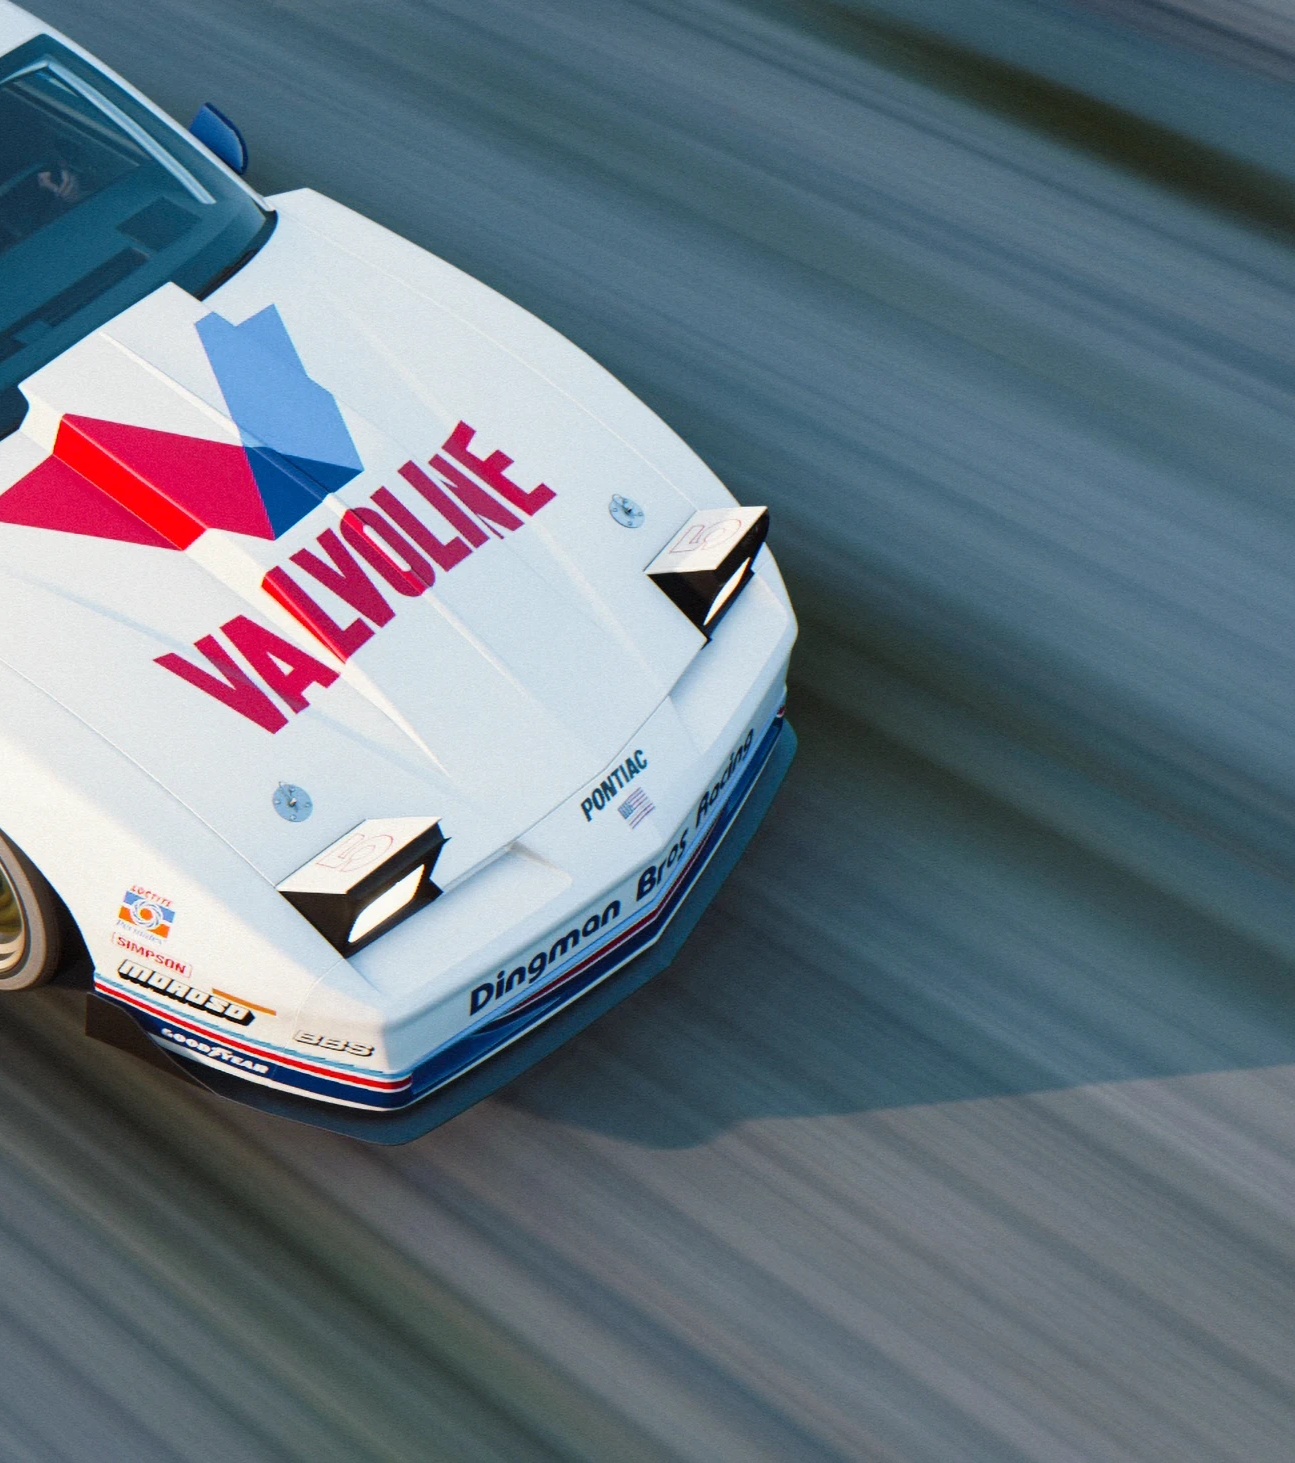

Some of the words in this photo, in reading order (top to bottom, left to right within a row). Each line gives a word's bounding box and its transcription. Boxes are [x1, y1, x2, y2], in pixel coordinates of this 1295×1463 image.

[152, 420, 557, 735] VALVOLINE
[580, 749, 648, 822] PONTIAC
[468, 899, 621, 1016] Dingman
[635, 827, 689, 902] Bros
[694, 728, 755, 828] Racing
[116, 936, 187, 974] SIMPSON
[293, 1029, 376, 1057] BBS
